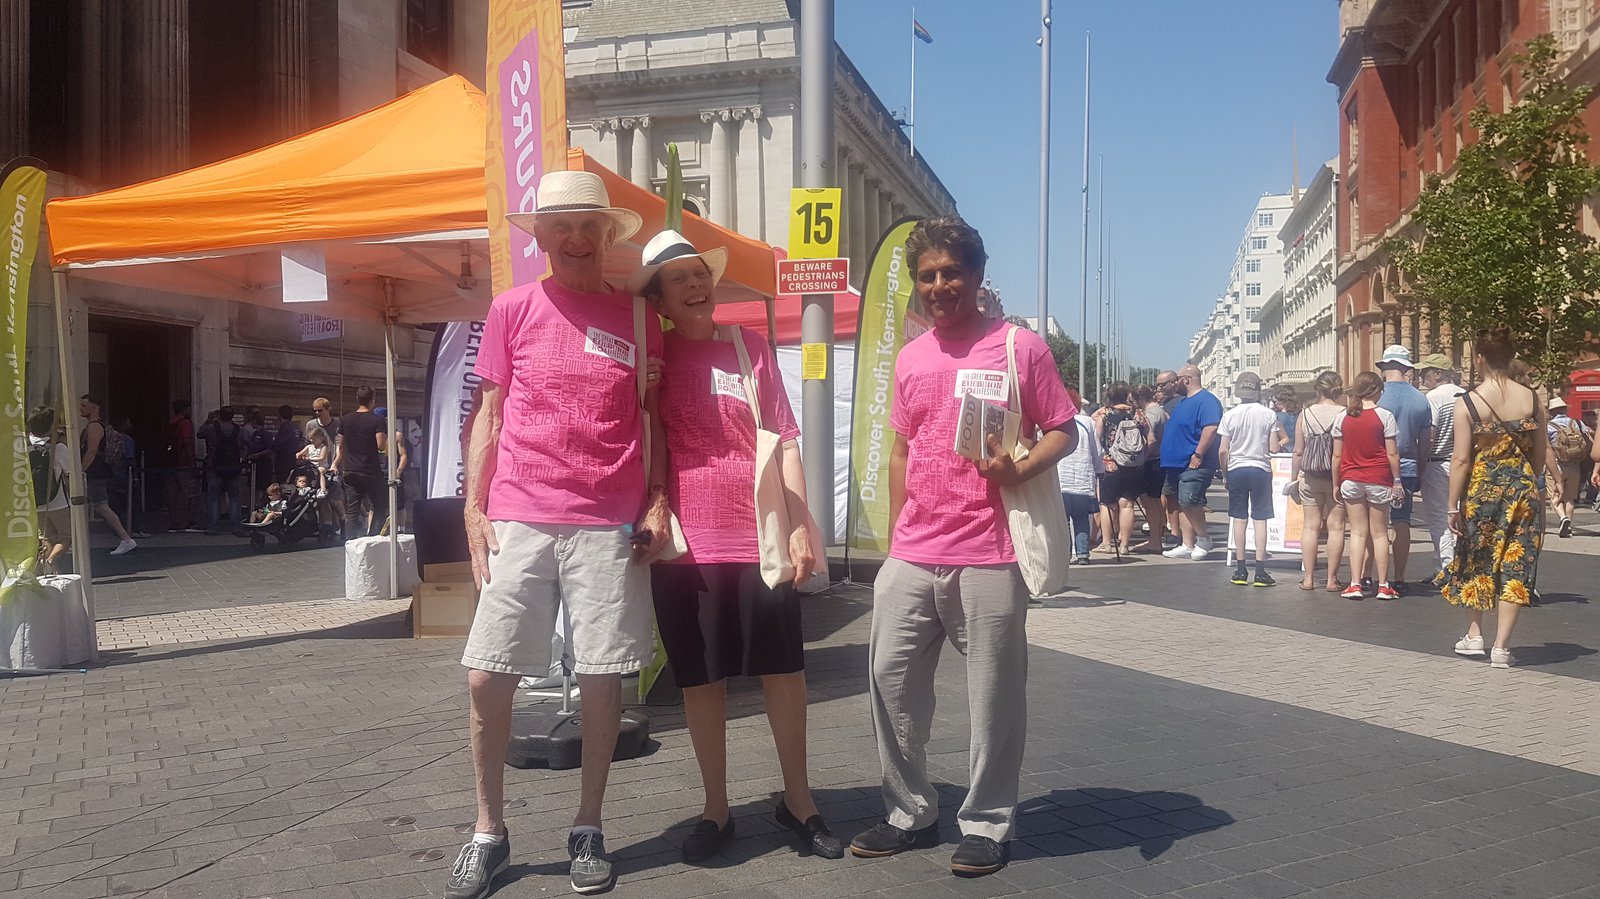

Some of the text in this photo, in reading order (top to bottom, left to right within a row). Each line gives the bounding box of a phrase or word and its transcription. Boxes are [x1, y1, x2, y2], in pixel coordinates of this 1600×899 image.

[796, 202, 833, 244] 15
[782, 271, 845, 281] PEDESTRIANS
[788, 281, 837, 291] CROSSING
[794, 262, 832, 271] BEWARE
[875, 245, 904, 356] Kensington
[531, 357, 547, 410] DISCOVER
[545, 357, 564, 400] EXPLORE
[586, 363, 606, 409] DESIGN
[868, 361, 889, 416] South
[961, 380, 1003, 389] EXHIBITION
[527, 411, 576, 426] SCIENCE
[962, 401, 975, 450] FOOD
[6, 425, 33, 538] Discover
[861, 420, 884, 502] Discover
[688, 490, 726, 498] PIONEER
[688, 498, 726, 506] PIONEER
